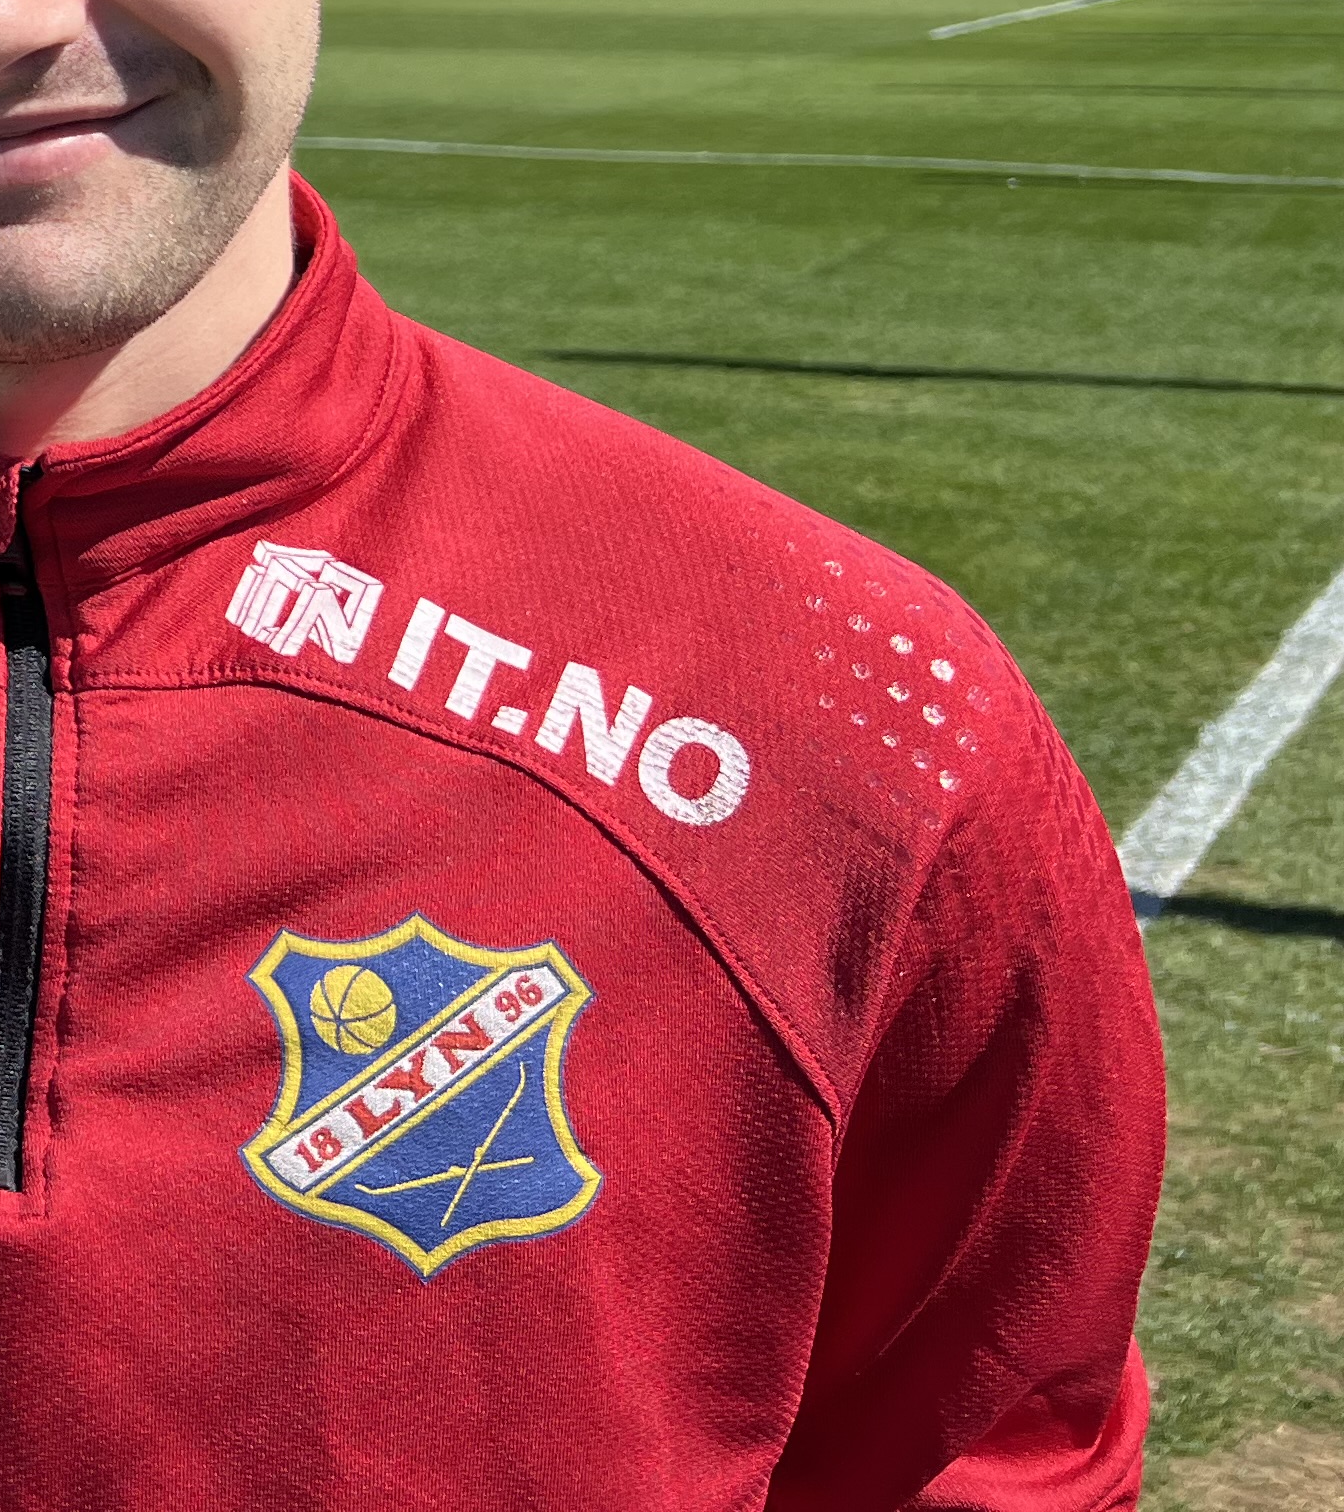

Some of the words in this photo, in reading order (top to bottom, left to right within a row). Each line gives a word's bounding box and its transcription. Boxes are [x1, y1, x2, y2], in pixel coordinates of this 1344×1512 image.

[387, 597, 750, 826] IT.NO
[293, 1129, 343, 1173] 18
[344, 1010, 495, 1140] LYN
[494, 972, 544, 1024] 96
